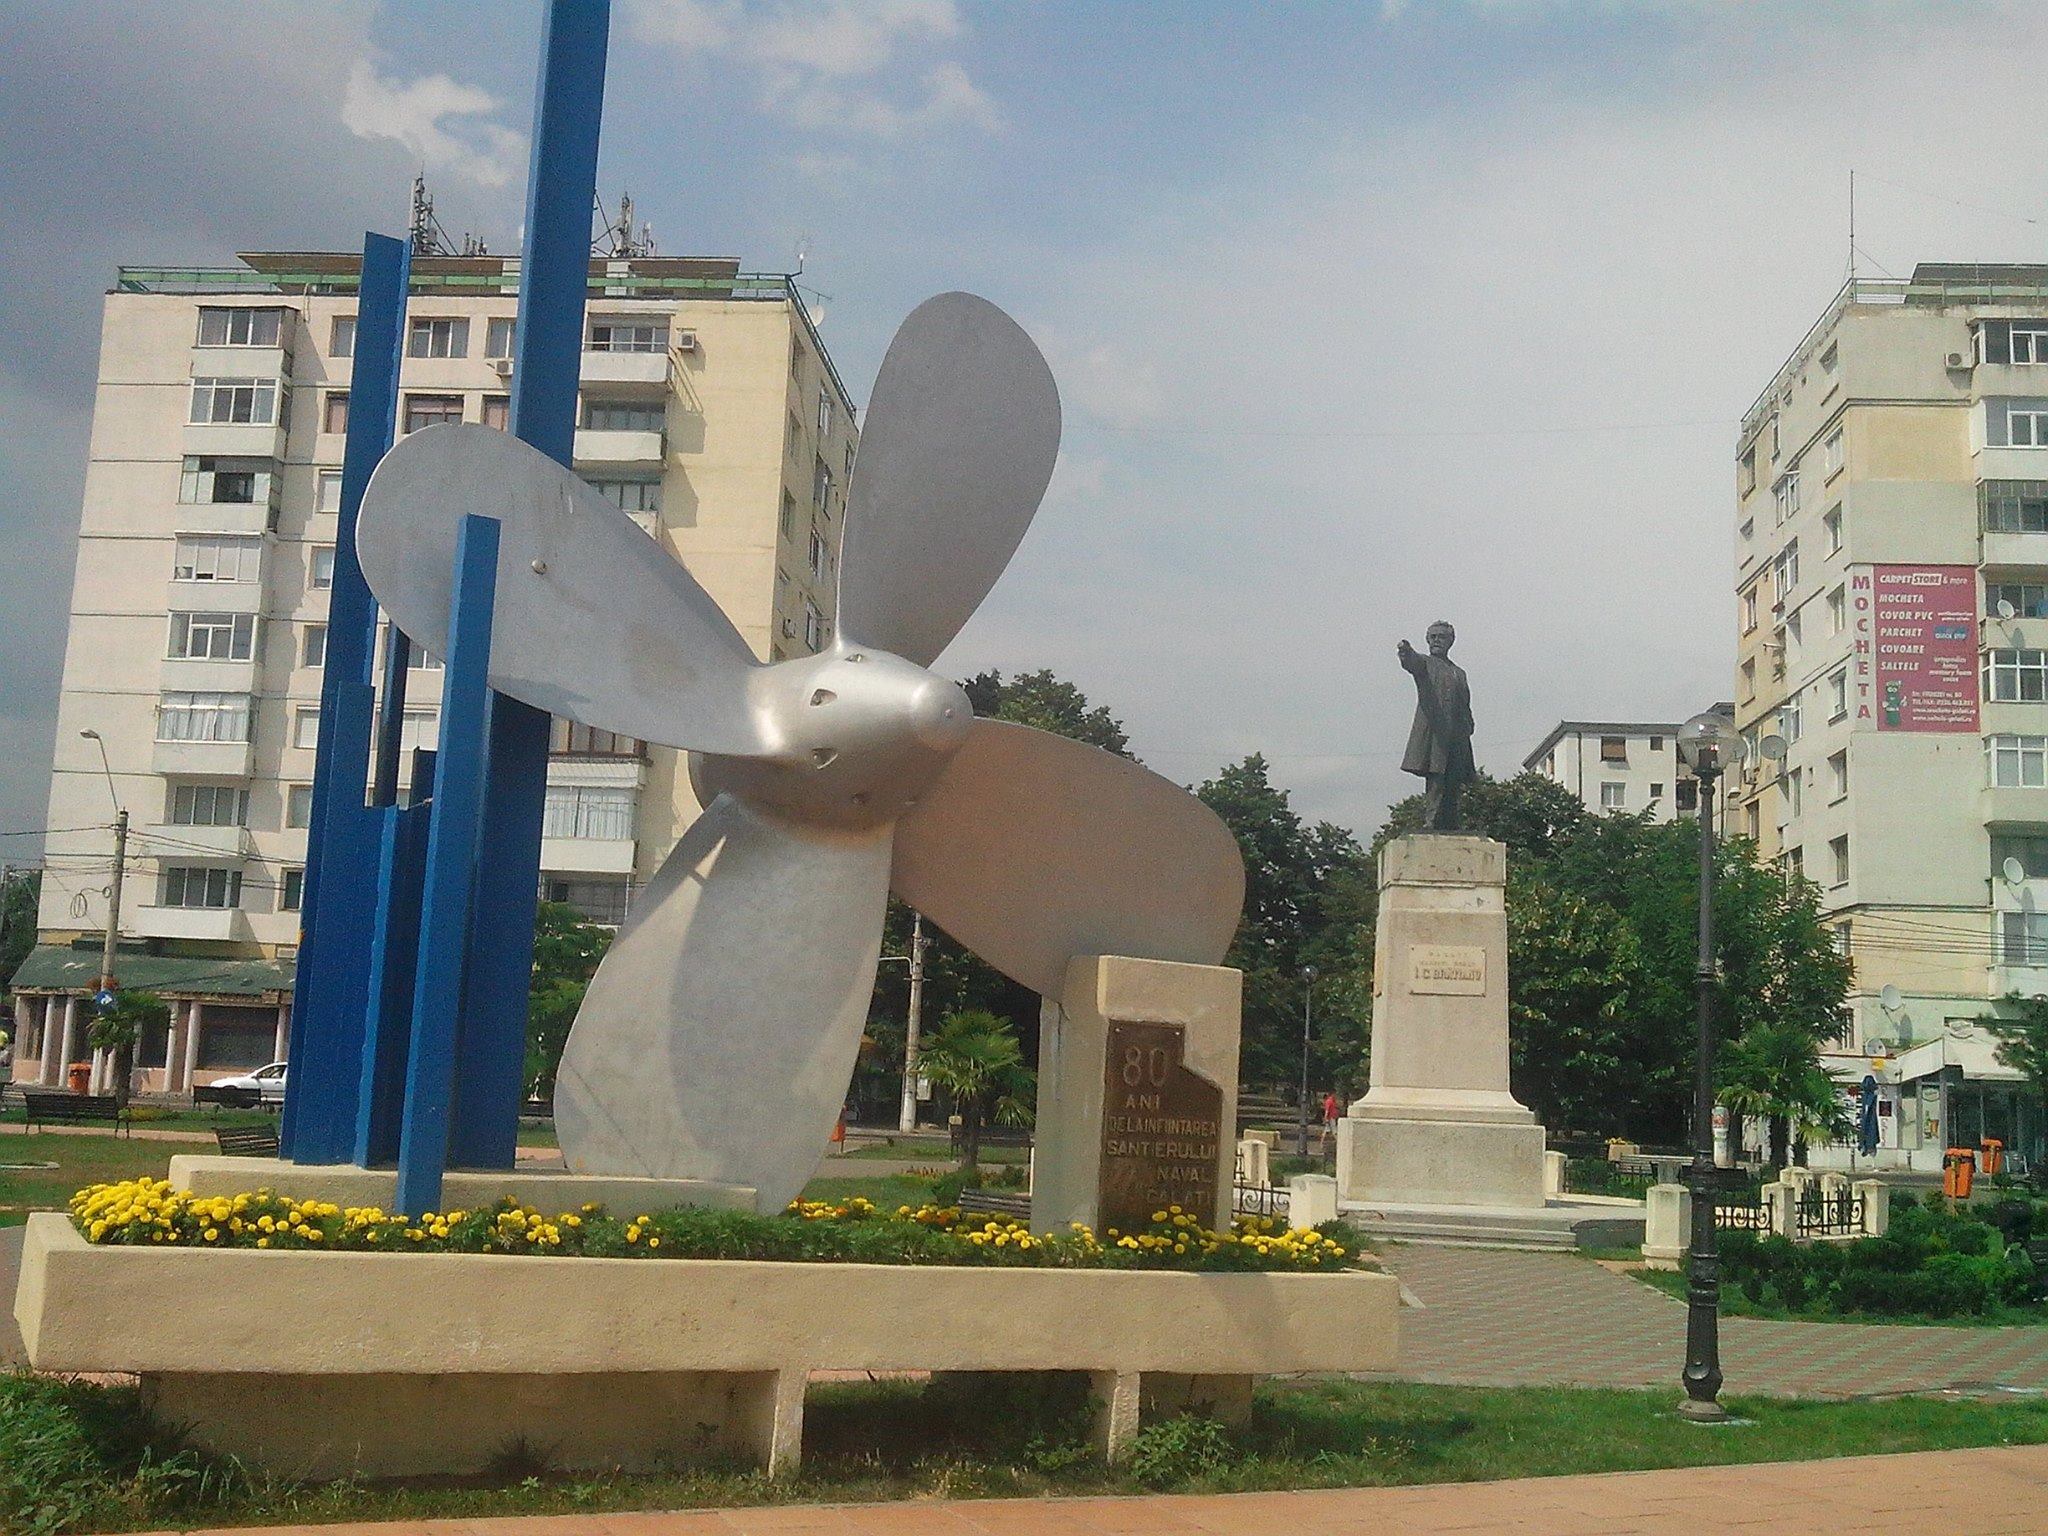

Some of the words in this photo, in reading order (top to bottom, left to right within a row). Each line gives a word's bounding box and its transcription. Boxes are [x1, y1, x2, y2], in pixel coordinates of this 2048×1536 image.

[1913, 574, 1940, 584] STORE
[1879, 594, 1924, 603] MOCHETA
[1879, 610, 1912, 620] COVOR
[1914, 611, 1933, 620] PVC
[1880, 627, 1923, 637] PARCHET
[1852, 575, 1871, 719] MOCHETA
[1880, 644, 1925, 654] COVOARE
[1880, 661, 1920, 671] SALTELE
[1122, 1046, 1168, 1087] 80
[1125, 1094, 1160, 1111] ANI
[1156, 1166, 1212, 1184] NAVAL
